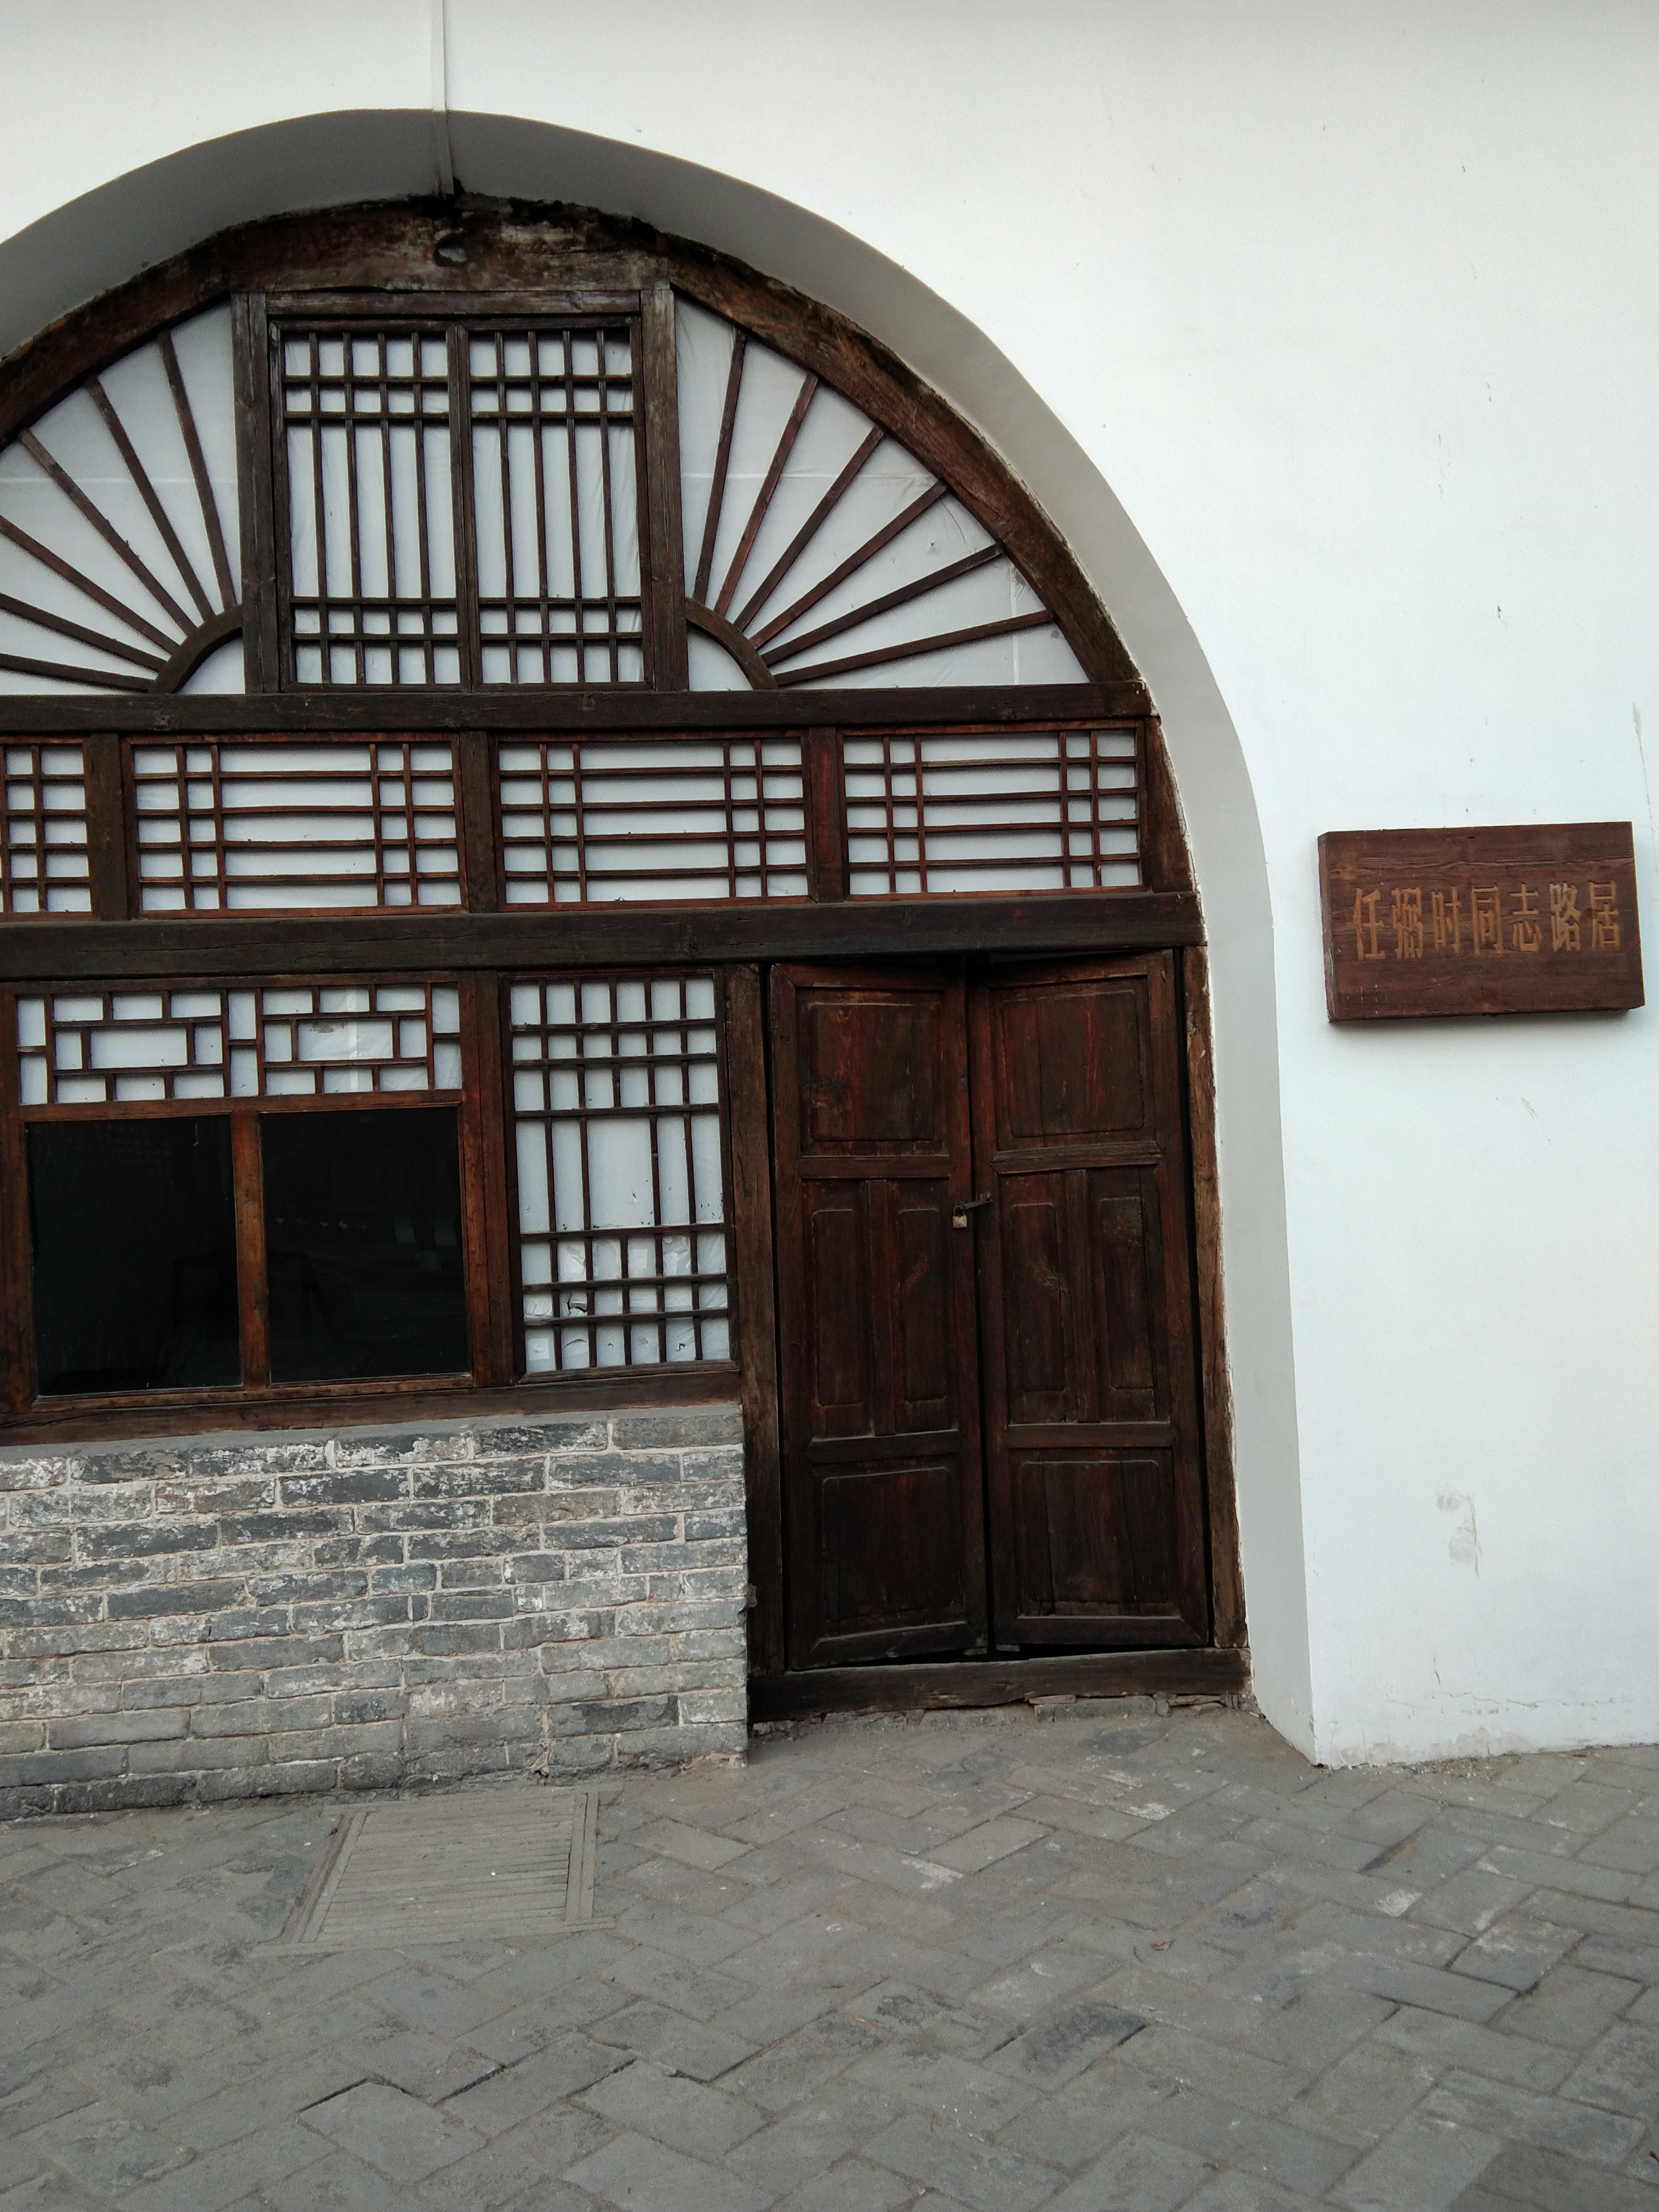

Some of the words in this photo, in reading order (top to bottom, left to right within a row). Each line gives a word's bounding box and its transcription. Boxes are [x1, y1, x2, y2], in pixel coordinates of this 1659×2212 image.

[1353, 880, 1620, 960] 任弼时同志路居
